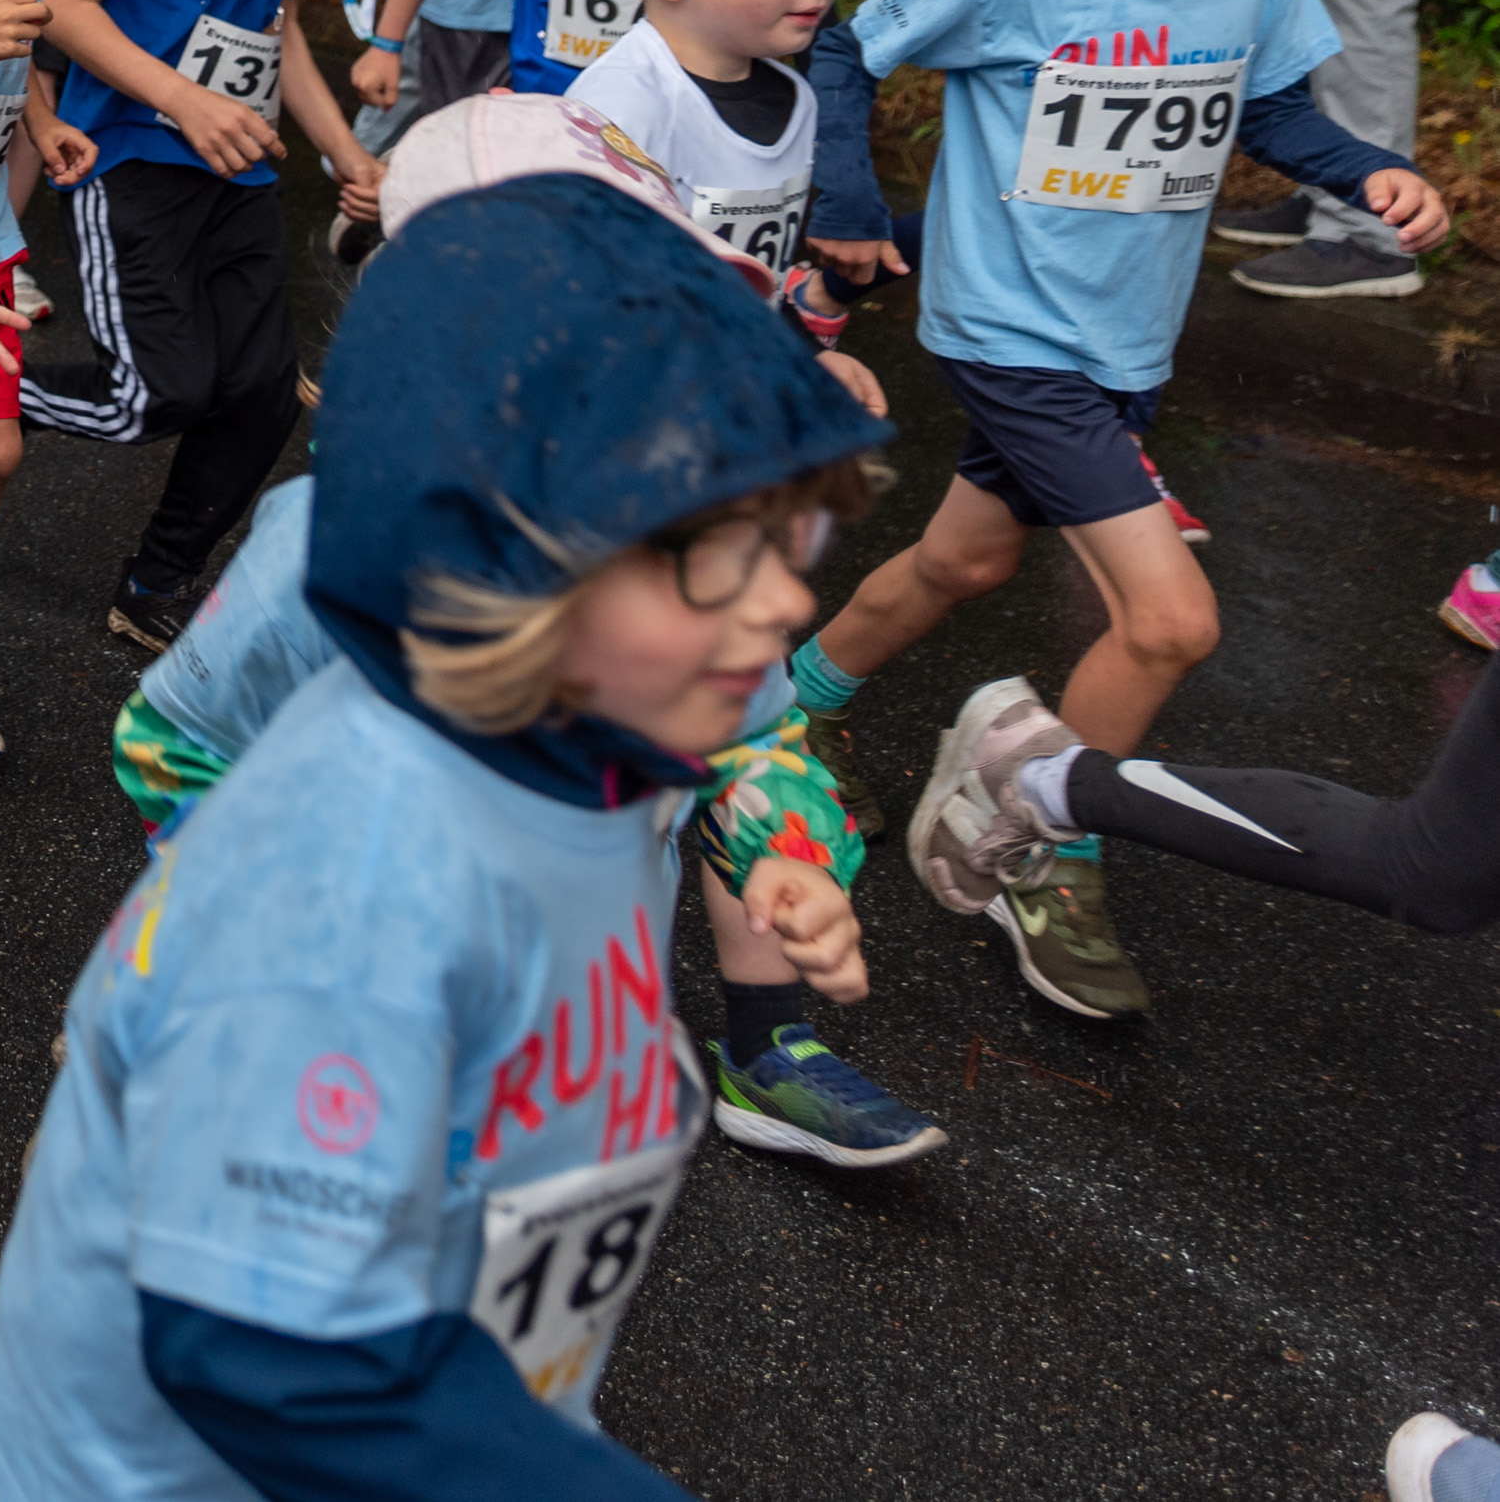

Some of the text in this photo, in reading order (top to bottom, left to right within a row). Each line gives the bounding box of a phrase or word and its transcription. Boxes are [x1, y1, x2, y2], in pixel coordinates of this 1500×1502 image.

[1054, 72, 1237, 91] Everstener Brunnenlauf
[1042, 90, 1235, 152] 1799
[1125, 157, 1162, 169] Lars
[1039, 167, 1132, 200] EWE
[1161, 171, 1217, 197] bruns
